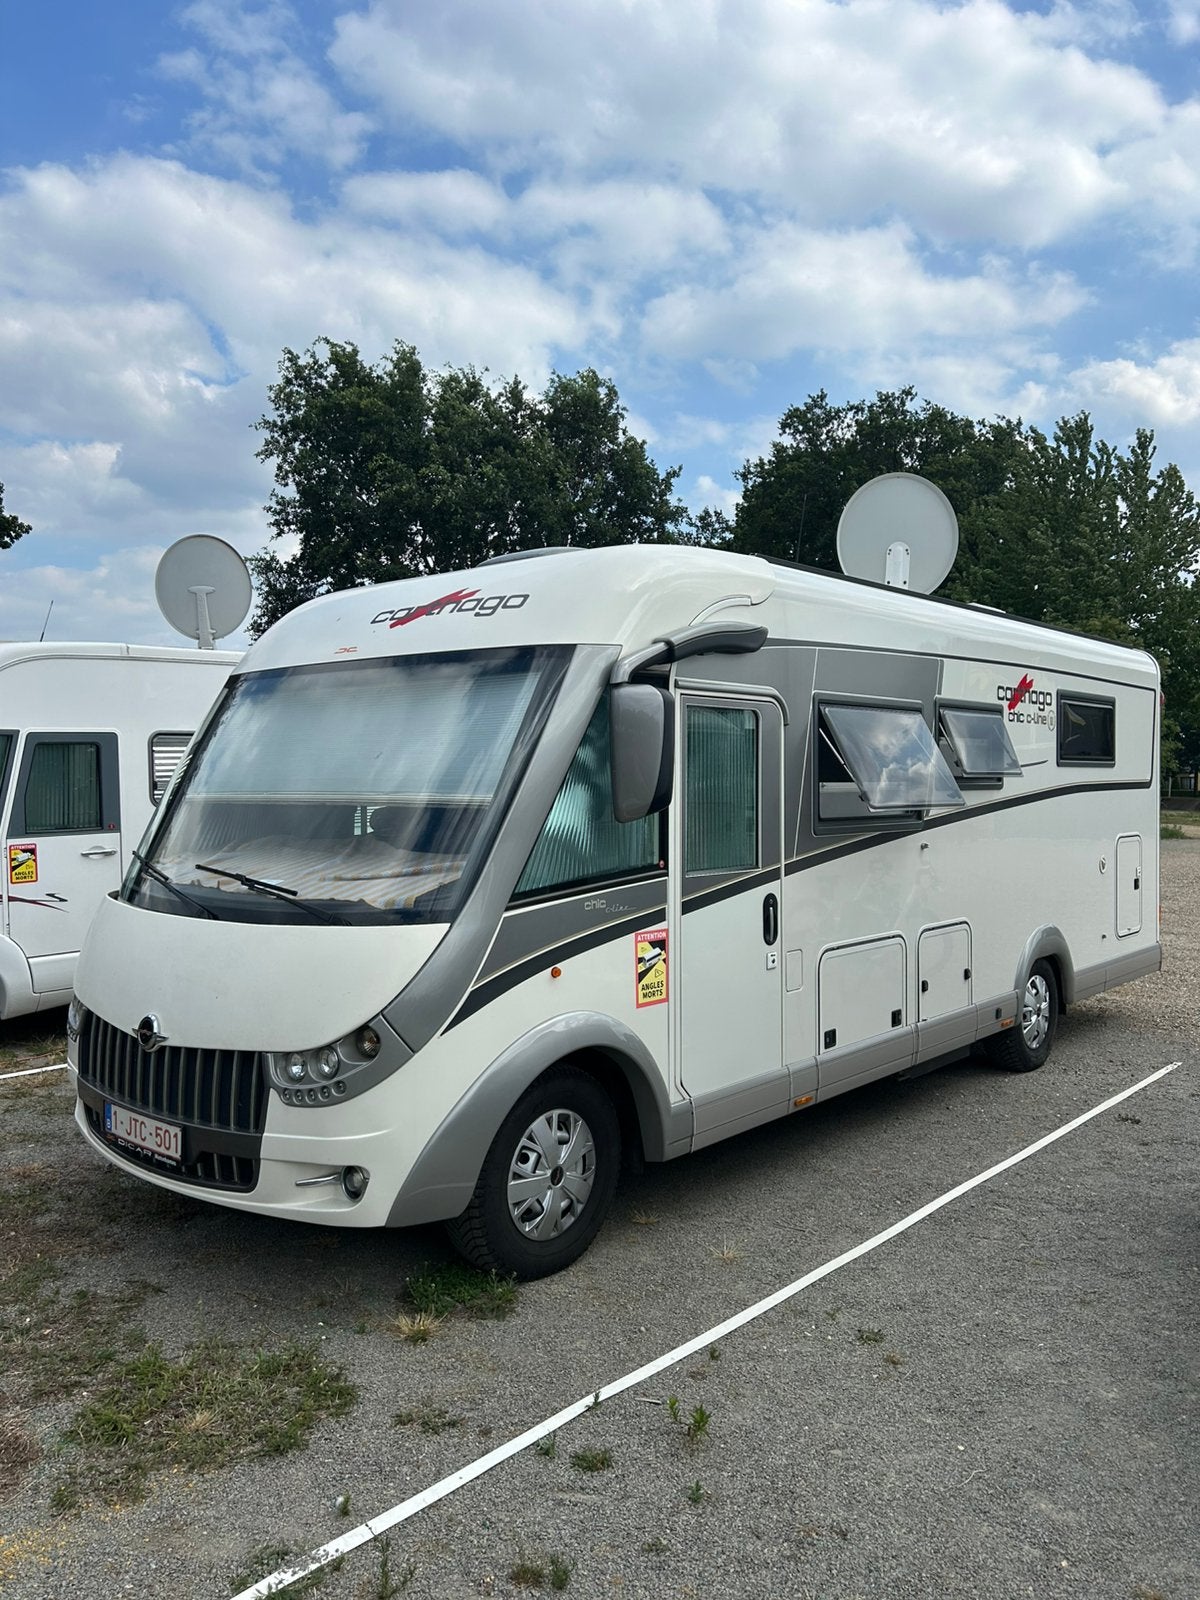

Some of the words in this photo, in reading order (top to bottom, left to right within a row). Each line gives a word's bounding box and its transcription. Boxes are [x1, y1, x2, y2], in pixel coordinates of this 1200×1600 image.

[1008, 711, 1025, 723] chic
[584, 898, 606, 910] chic
[637, 932, 667, 941] ATTENTION
[641, 980, 665, 992] ANGLES
[642, 989, 664, 999] MORTS
[113, 1110, 179, 1154] 1-JTC-501
